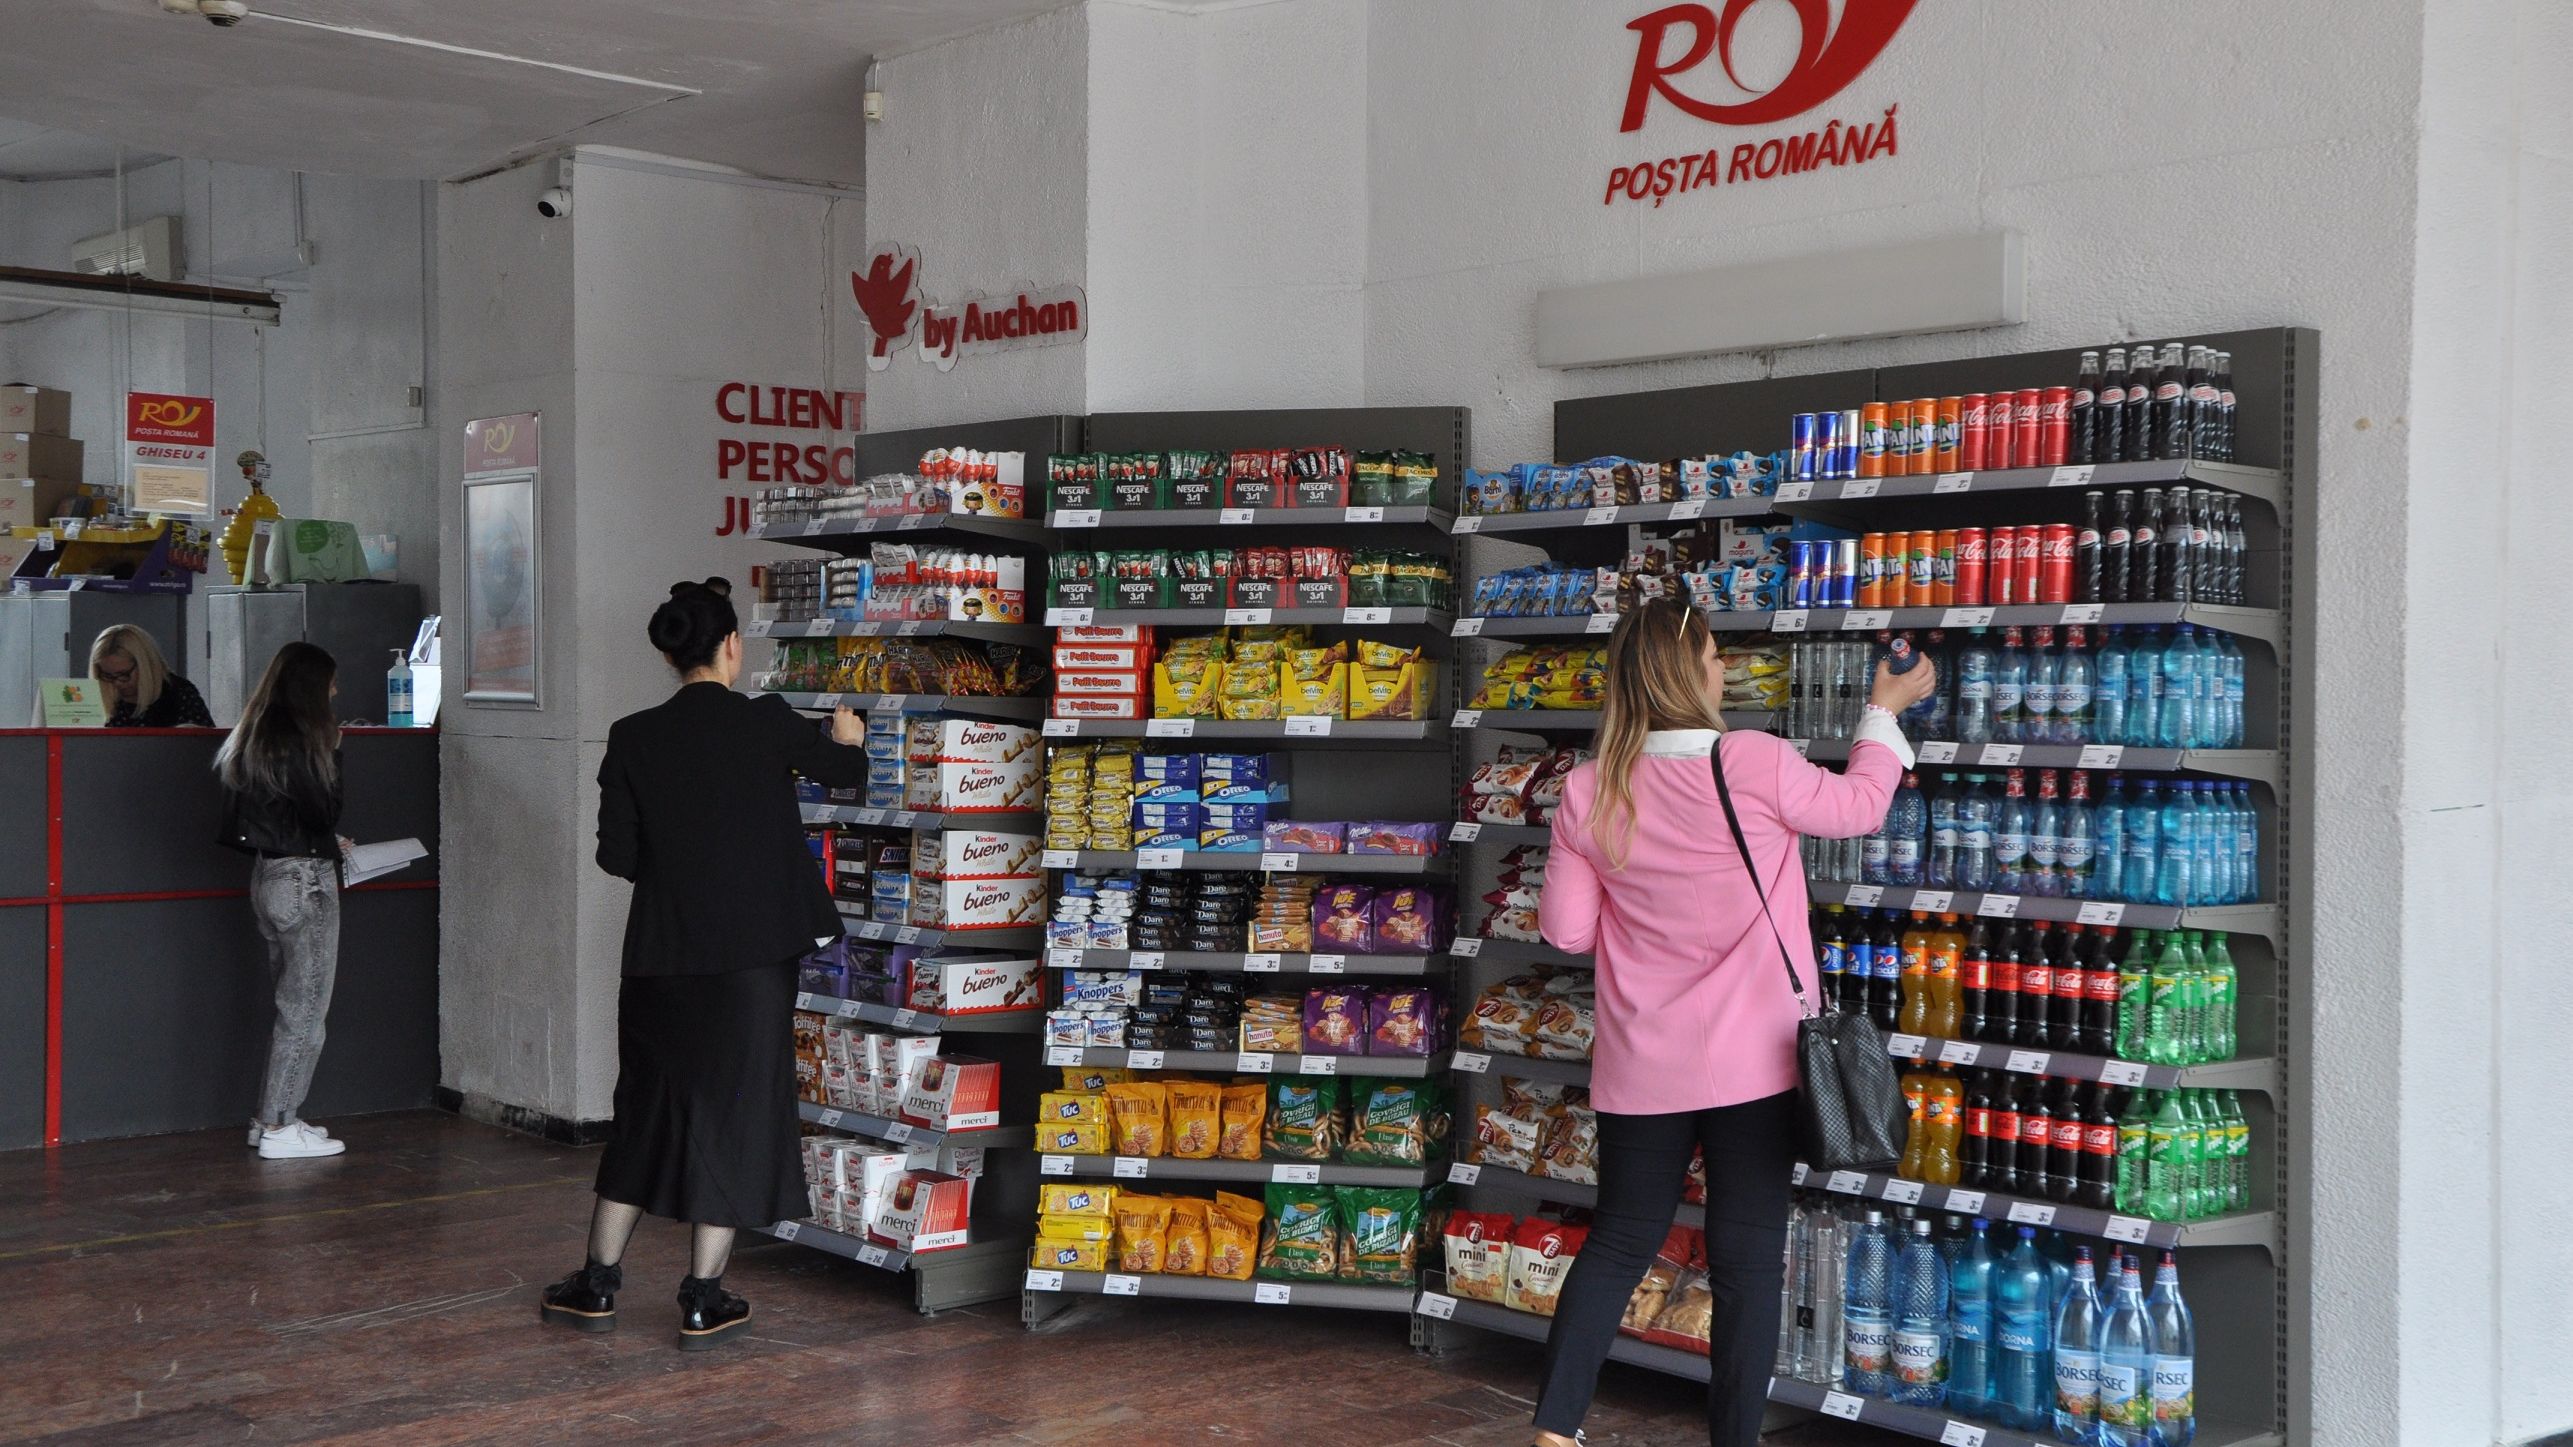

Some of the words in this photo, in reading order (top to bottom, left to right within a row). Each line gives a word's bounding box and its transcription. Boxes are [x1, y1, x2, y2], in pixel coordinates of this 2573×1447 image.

[1604, 149, 1718, 208] POȘTA
[1727, 103, 1897, 184] ROMÂNĂ
[923, 309, 957, 358] by
[962, 294, 1079, 343] Auchan
[136, 446, 193, 460] GHISEU
[196, 450, 206, 460] 4
[961, 728, 1006, 745] bueno
[959, 774, 1005, 793] bueno
[1151, 786, 1182, 797] OREO
[1219, 786, 1249, 797] OREO
[1266, 823, 1289, 833] Milka
[1350, 827, 1372, 838] Milka
[1151, 834, 1182, 845] OREO
[1217, 835, 1248, 846] OREO
[963, 842, 1009, 861] bueno
[963, 891, 1010, 911] bueno
[1199, 925, 1218, 933] Dare
[1258, 930, 1283, 940] hanuta
[962, 973, 1008, 995] bueno
[1077, 984, 1124, 1000] Knoppers
[1139, 1012, 1157, 1020] Dare
[1249, 1031, 1272, 1040] hanuta
[1085, 1077, 1103, 1088] TUC
[909, 1094, 946, 1113] merci
[1061, 1104, 1079, 1116] TUC
[1370, 1102, 1410, 1118] COVRIGI
[961, 1116, 988, 1126] merci
[1369, 1117, 1381, 1125] DE
[1059, 1134, 1076, 1146] TUC
[1069, 1194, 1089, 1208] TUC
[881, 1214, 918, 1232] merci
[928, 1237, 956, 1246] merci
[1058, 1250, 1077, 1262] TUC
[1459, 1247, 1486, 1262] mini
[1528, 1261, 1559, 1278] mini
[1848, 1329, 1890, 1346] BORSEC
[1893, 1339, 1935, 1358] BORSEC
